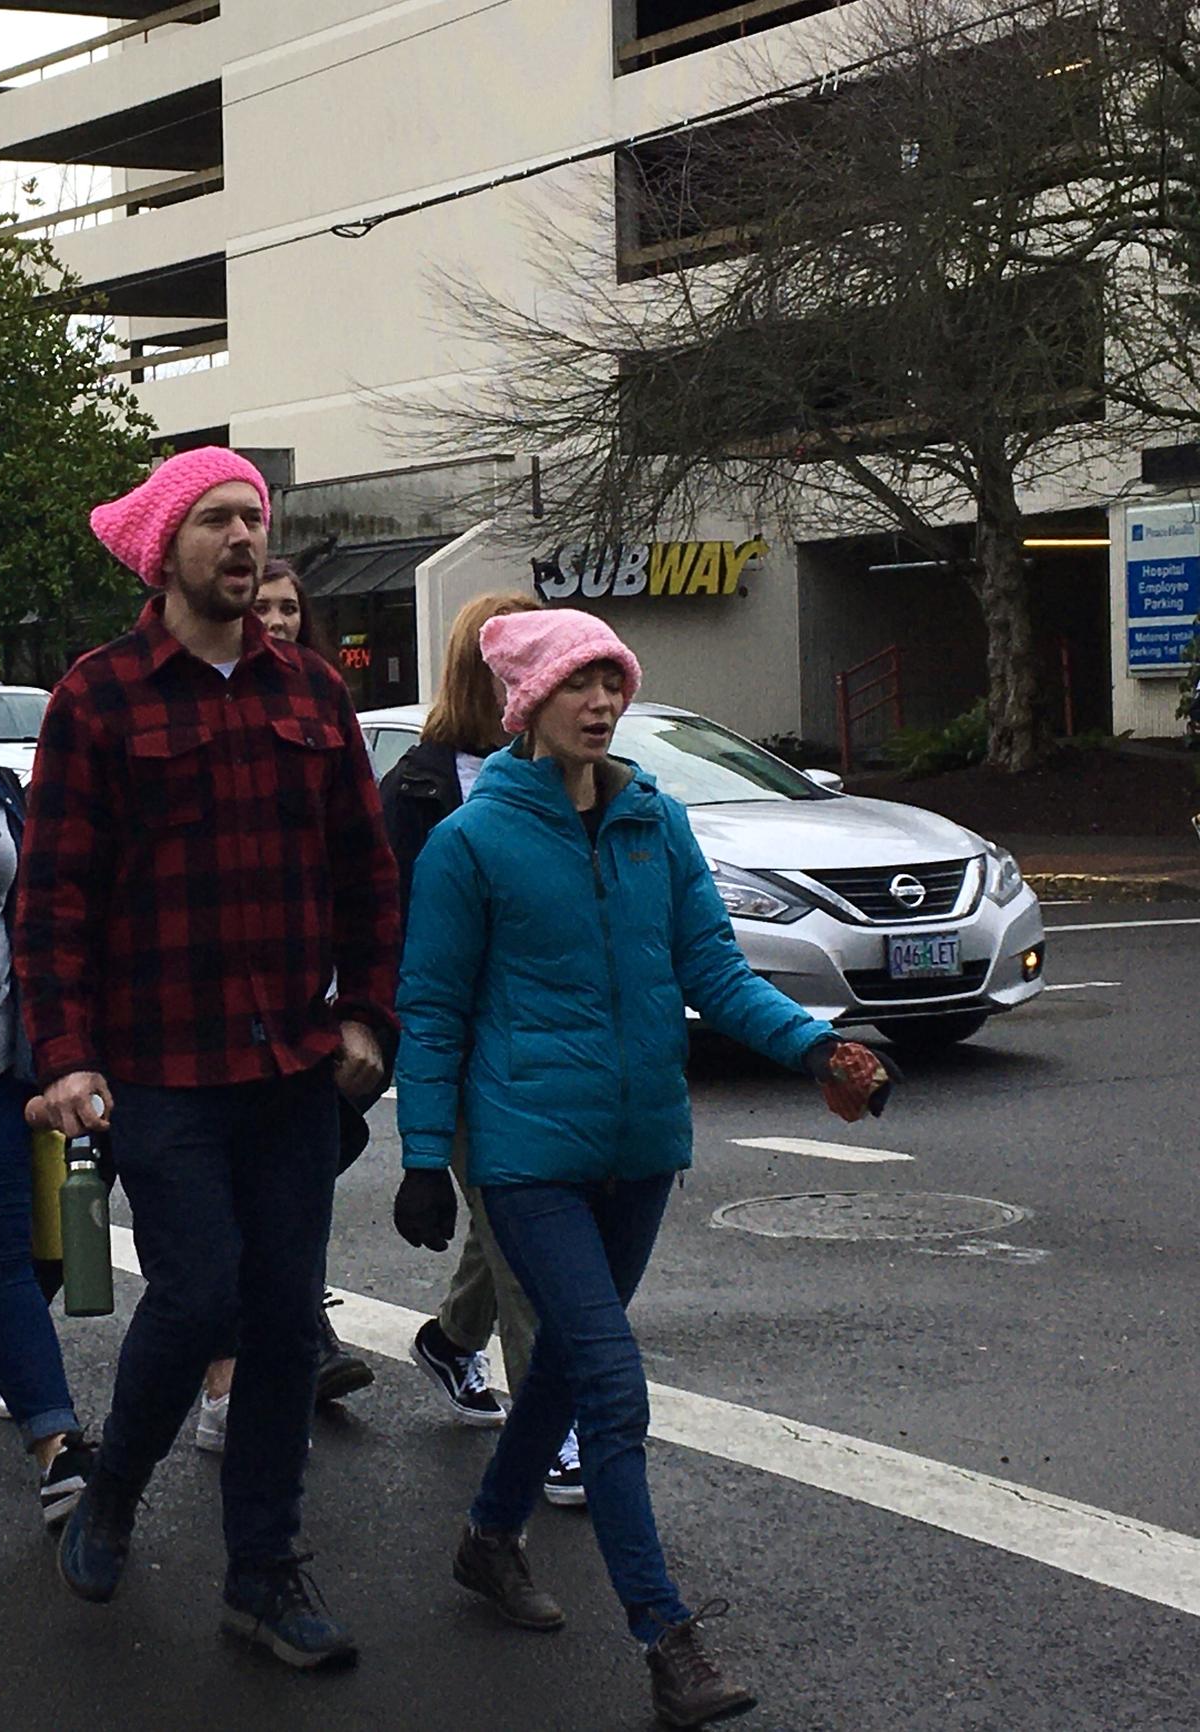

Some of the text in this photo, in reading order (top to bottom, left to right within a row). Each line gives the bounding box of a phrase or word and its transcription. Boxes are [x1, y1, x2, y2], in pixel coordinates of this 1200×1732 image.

[531, 534, 769, 600] SUBWAY
[1142, 562, 1185, 578] Hospital
[1138, 581, 1189, 595] Employee
[1144, 598, 1184, 611] Parking
[340, 648, 370, 668] OPEN
